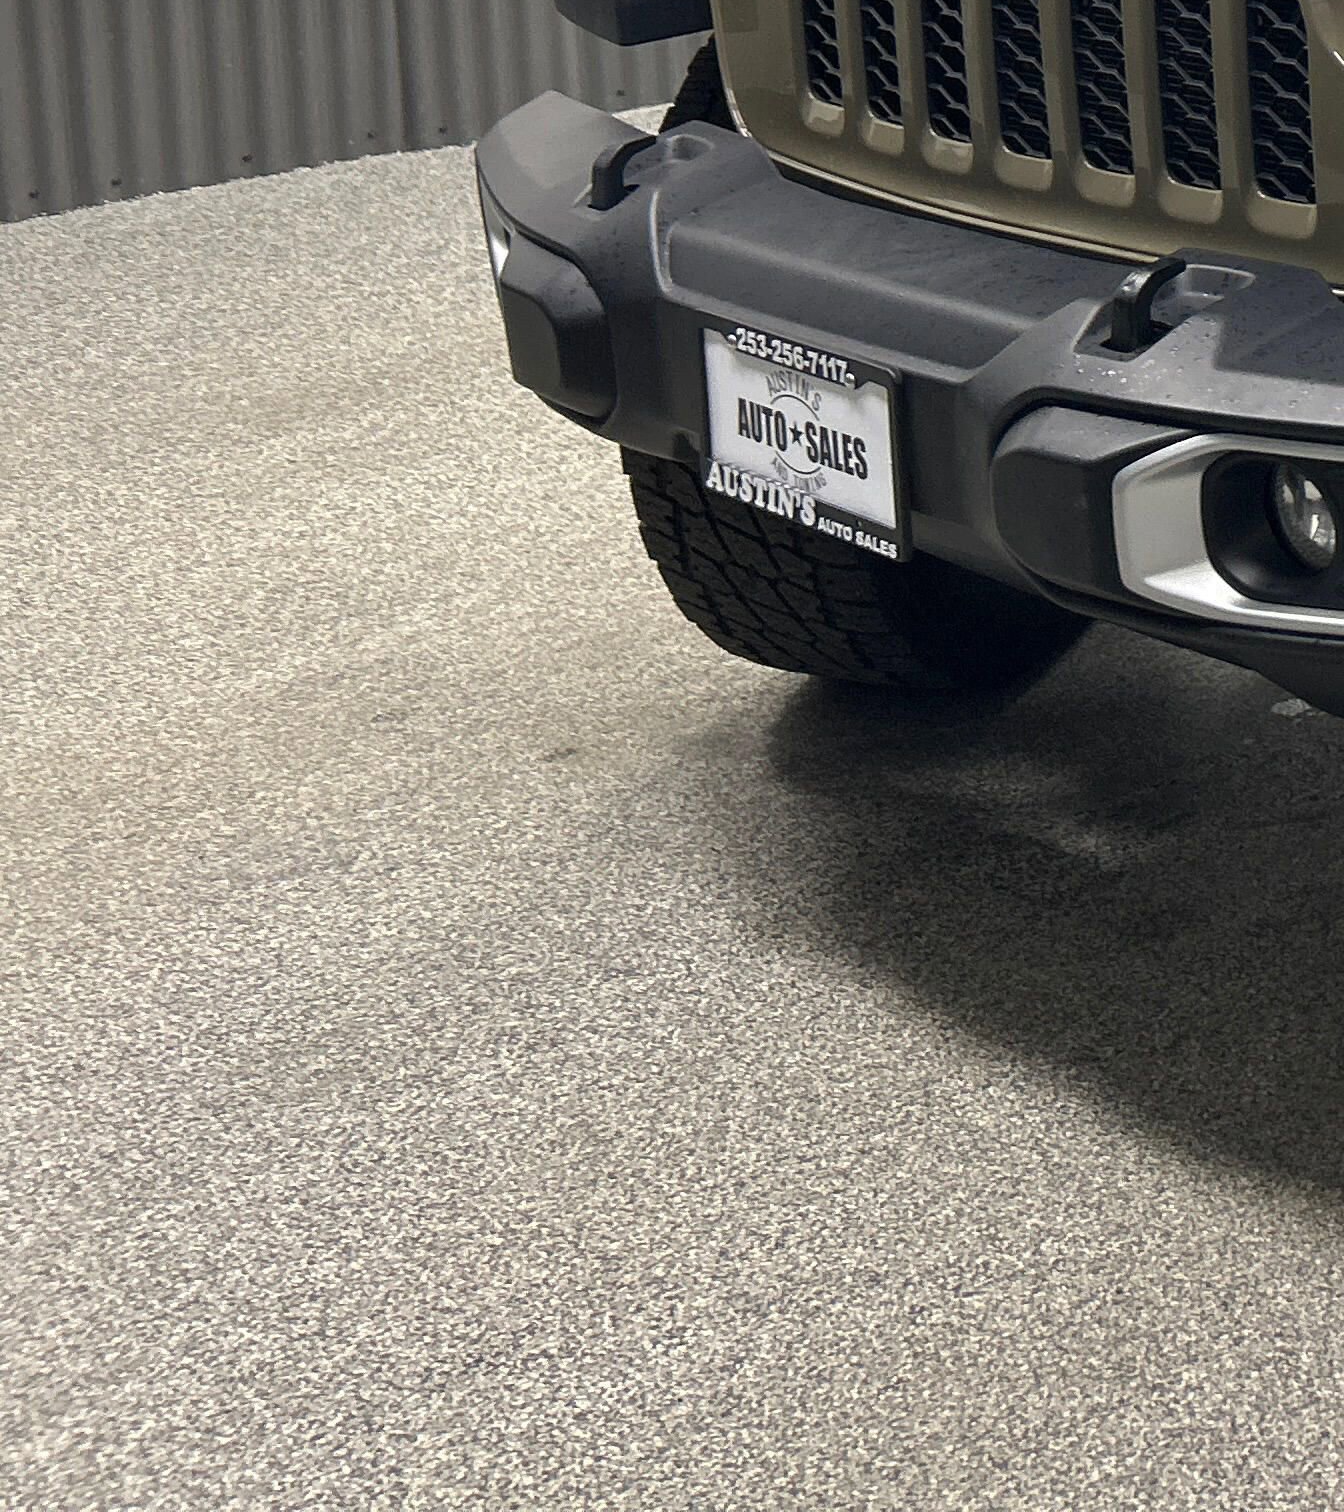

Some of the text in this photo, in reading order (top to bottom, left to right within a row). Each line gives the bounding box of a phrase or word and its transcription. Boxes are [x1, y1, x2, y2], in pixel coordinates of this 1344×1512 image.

[735, 328, 848, 386] 253-256-7117
[737, 397, 869, 480] AUTO SALES
[706, 461, 898, 560] AUSTIN'S AUTO SALES
